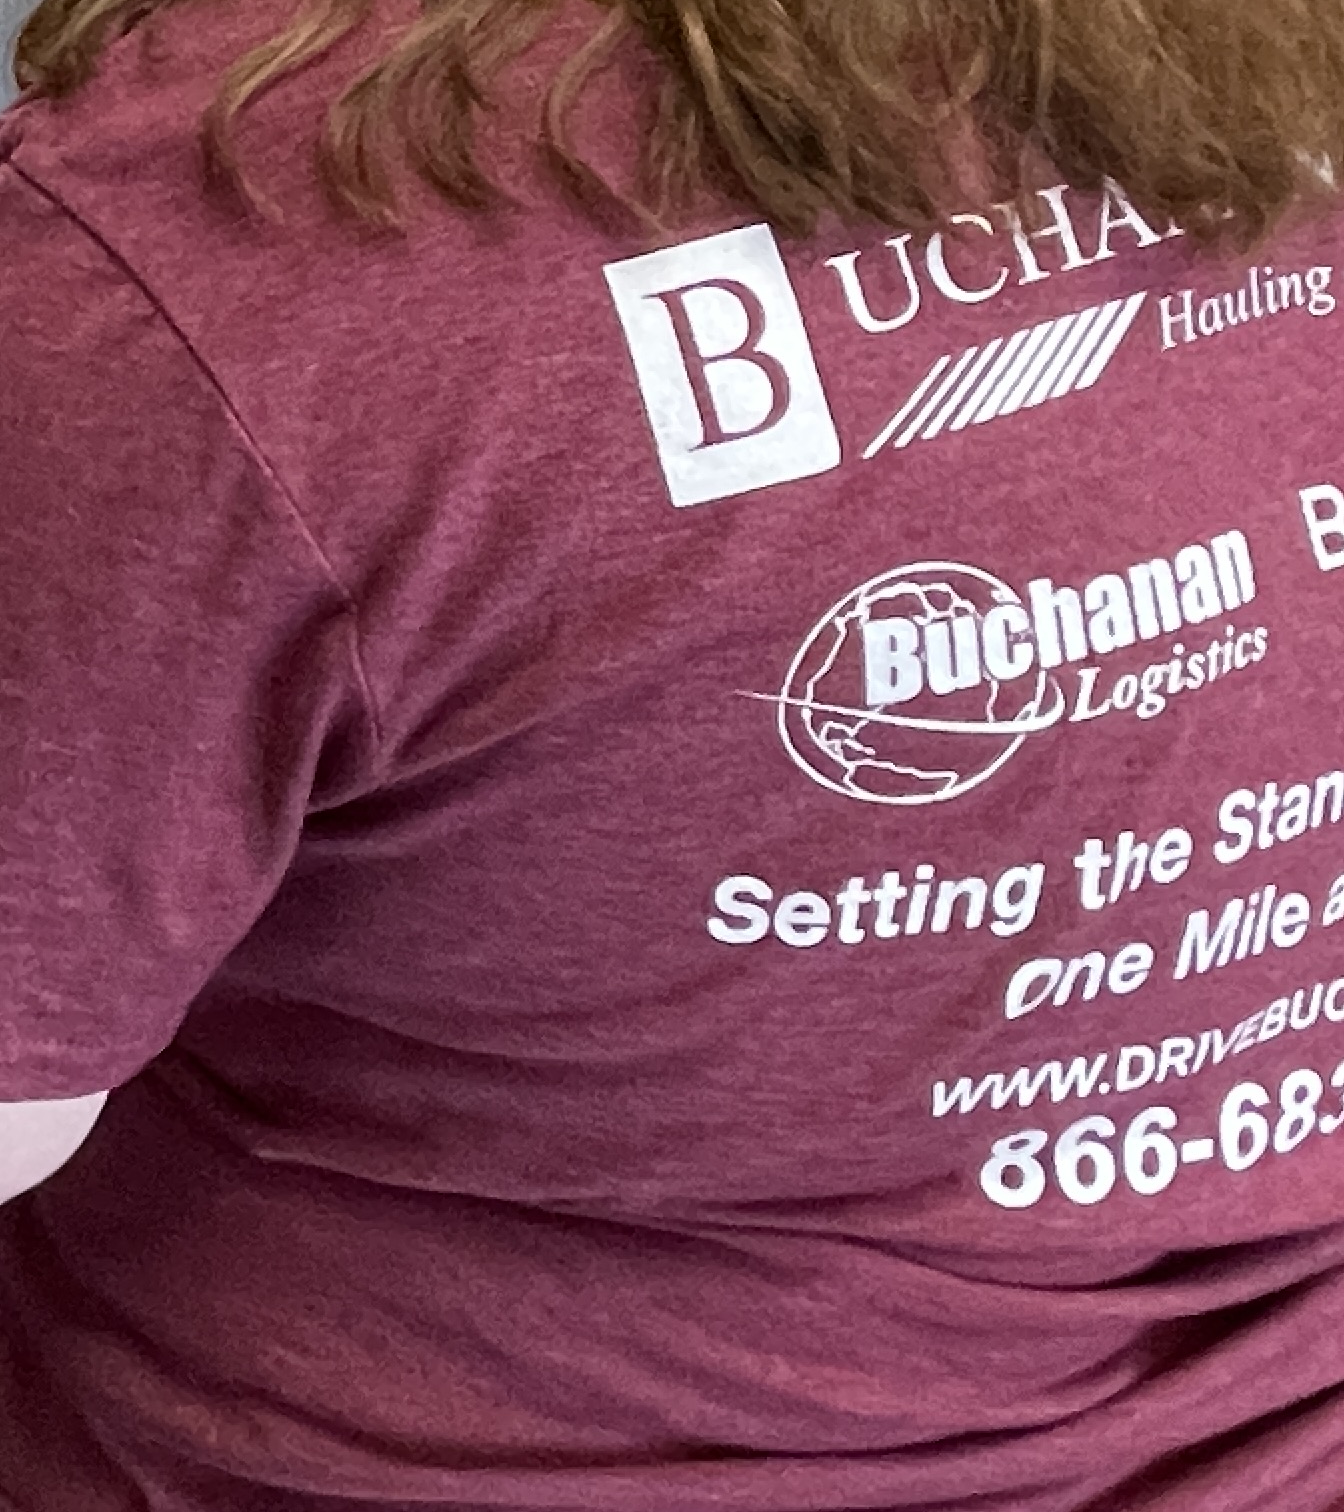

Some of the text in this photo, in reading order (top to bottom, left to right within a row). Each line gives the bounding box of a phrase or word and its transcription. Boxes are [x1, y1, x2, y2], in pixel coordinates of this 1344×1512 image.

[642, 173, 1186, 454] B UCHA
[1158, 265, 1337, 352] Hauling
[862, 529, 1257, 707] Buchanan
[1067, 624, 1270, 723] Logistics
[706, 769, 1344, 949] Setting the Stan
[1003, 941, 1155, 1021] One
[1171, 883, 1311, 981] Mile
